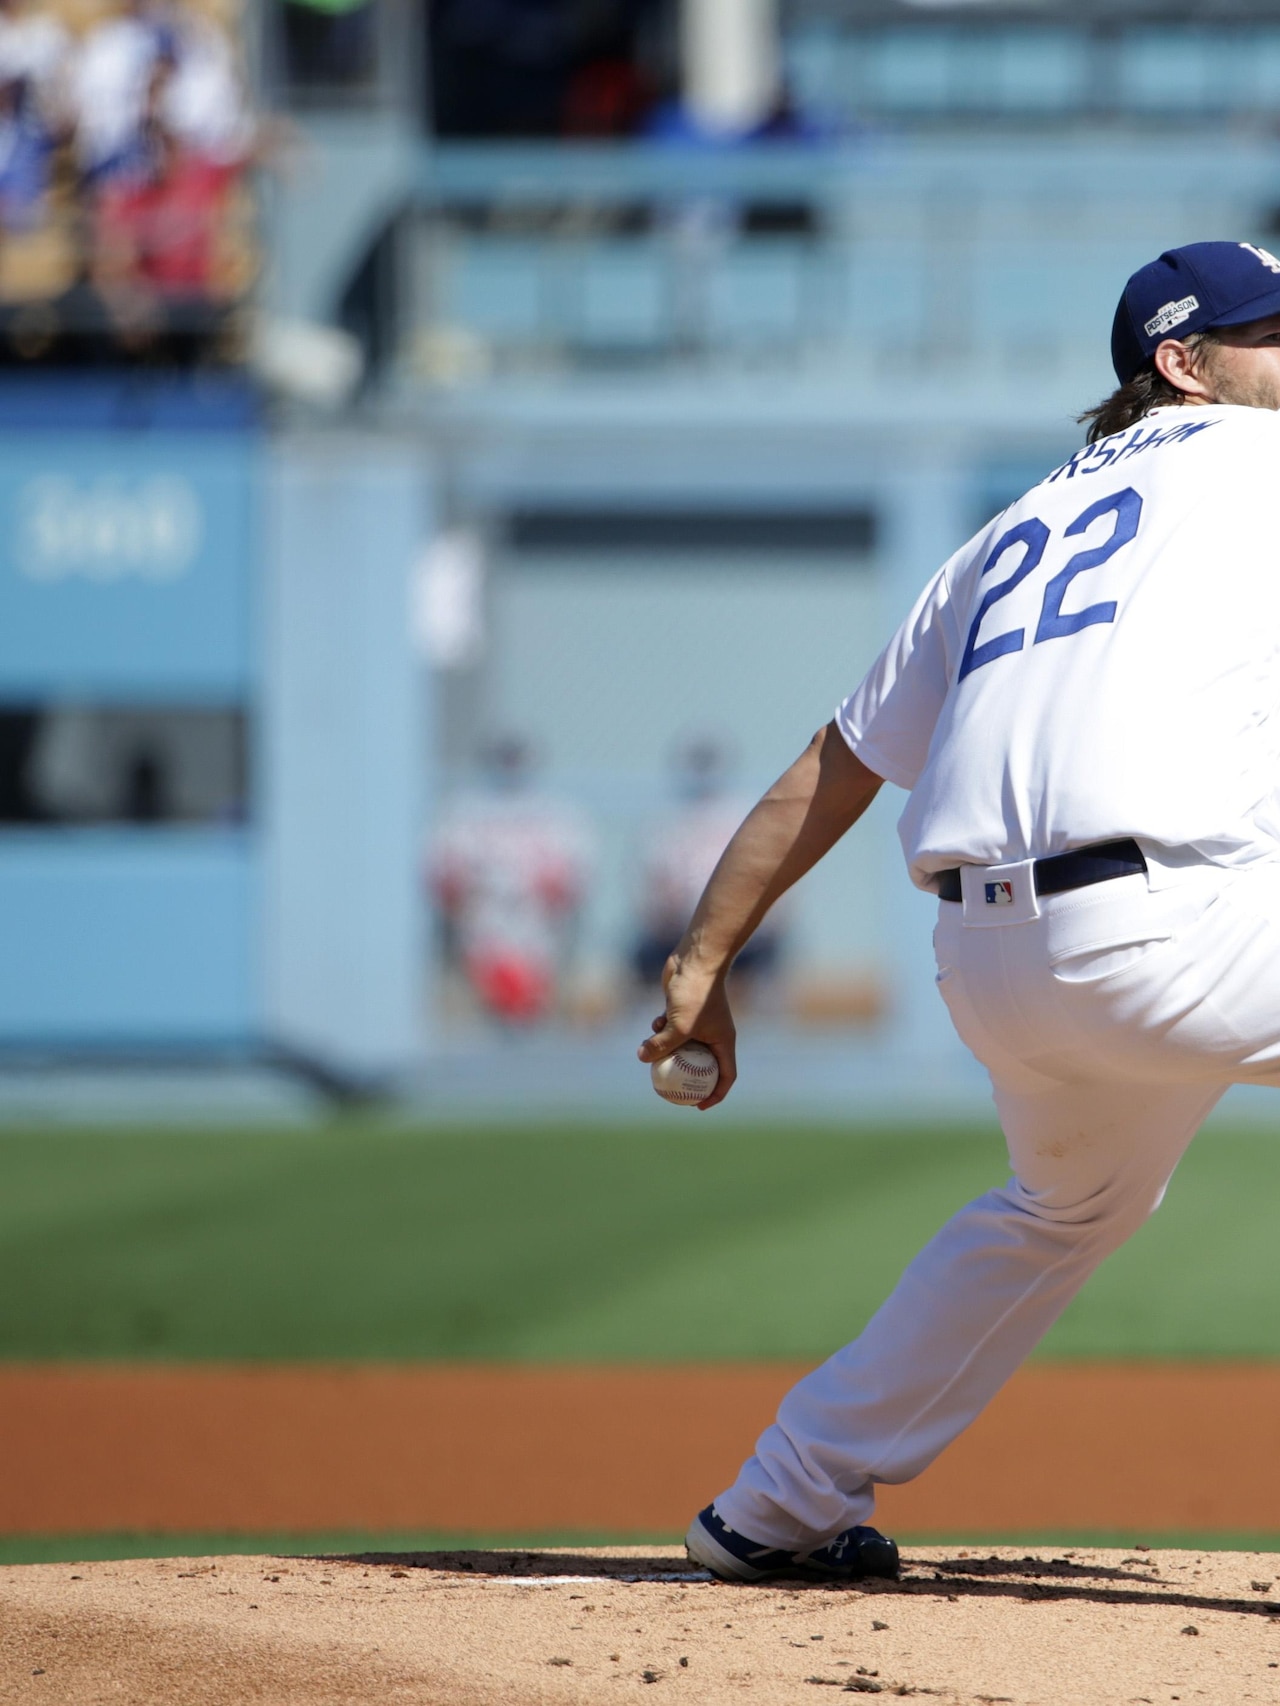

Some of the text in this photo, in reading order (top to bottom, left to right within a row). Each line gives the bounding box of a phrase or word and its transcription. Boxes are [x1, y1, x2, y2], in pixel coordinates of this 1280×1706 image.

[1146, 297, 1197, 335] POSTSEASON
[1028, 418, 1224, 490] RSHAW
[957, 486, 1144, 685] 22
